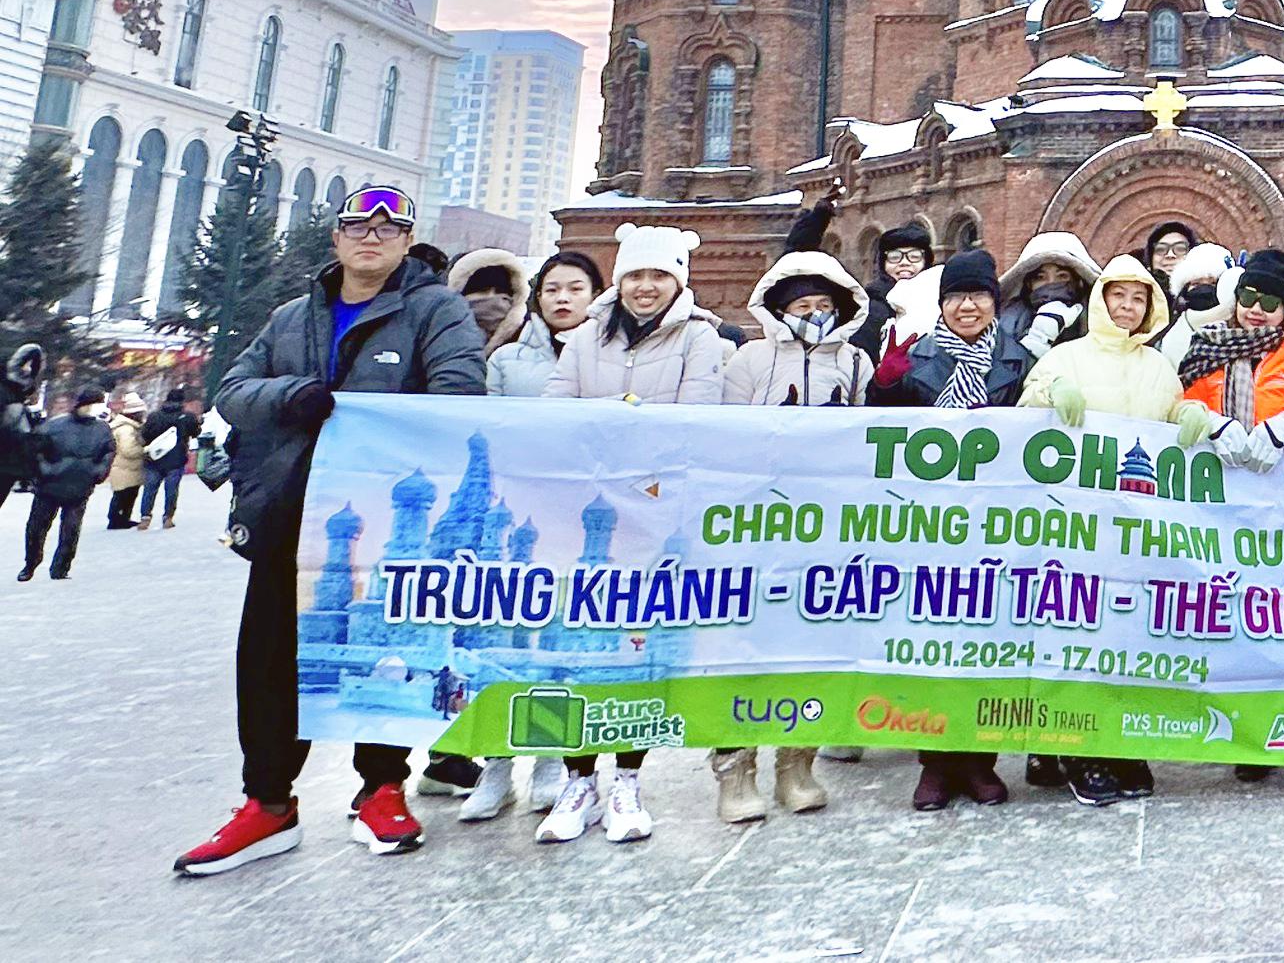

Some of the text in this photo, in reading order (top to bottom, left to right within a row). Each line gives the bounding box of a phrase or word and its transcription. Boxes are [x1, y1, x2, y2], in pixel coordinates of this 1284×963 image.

[866, 426, 999, 481] TOP
[702, 488, 823, 545] CHÀO
[839, 489, 969, 545] MỪNG
[981, 494, 1098, 554] ĐOÀN
[1113, 516, 1222, 564] THAM
[384, 554, 552, 622] TRÙNG
[569, 559, 753, 623] KHÁNH
[804, 554, 900, 615] CÁP
[912, 557, 1003, 620] NHĨ
[1011, 559, 1100, 624] TÂN
[1148, 571, 1237, 633] THẾ
[884, 638, 1034, 668] 10.01.2024
[1062, 644, 1209, 683] 17.01.2024
[586, 717, 684, 743] Tourist
[733, 695, 823, 732] tugo
[1054, 711, 1099, 731] TRAVEL
[1122, 714, 1203, 733] PYS Travel
